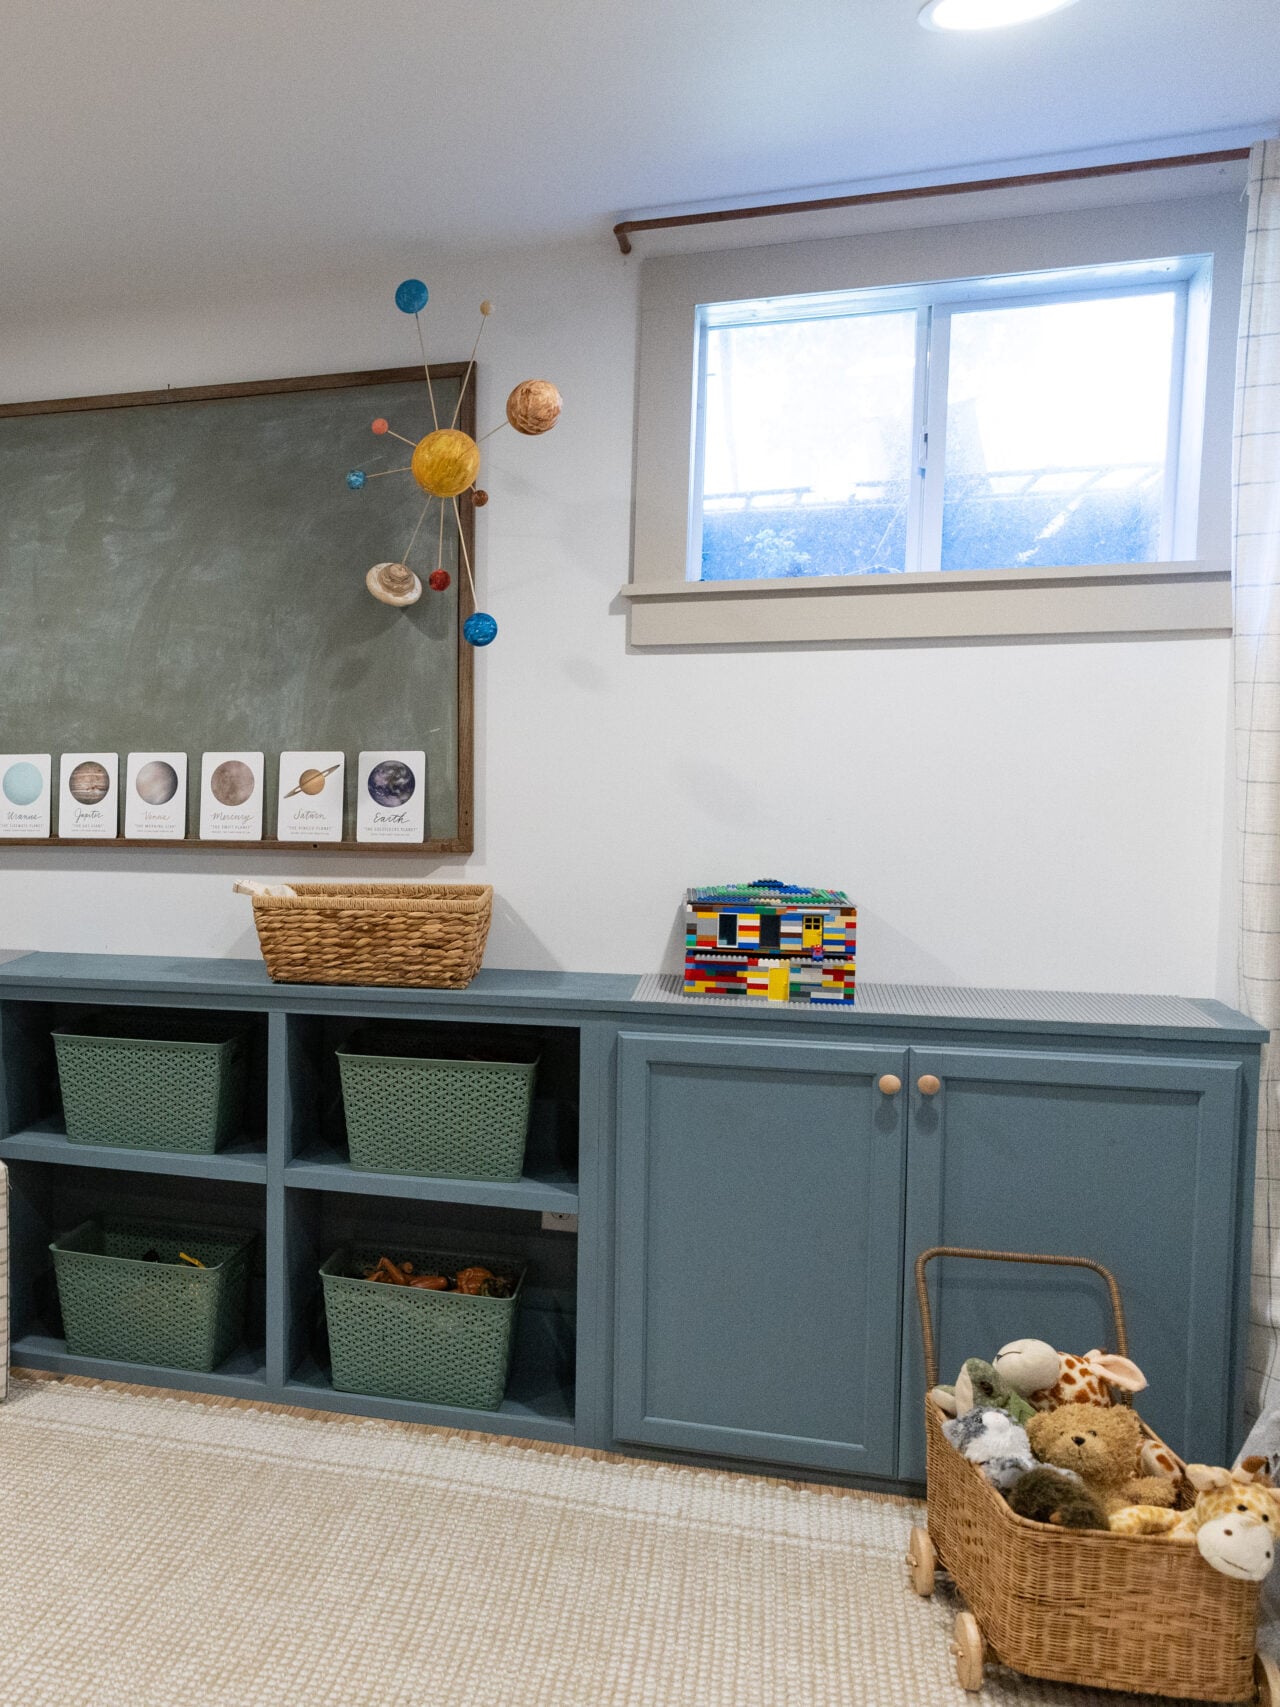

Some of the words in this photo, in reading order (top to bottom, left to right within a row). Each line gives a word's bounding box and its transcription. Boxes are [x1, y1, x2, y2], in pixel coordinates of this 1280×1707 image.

[74, 808, 103, 823] Jupiter
[210, 811, 255, 824] Mercury
[293, 808, 327, 821] Saturn
[373, 811, 410, 823] Earth
